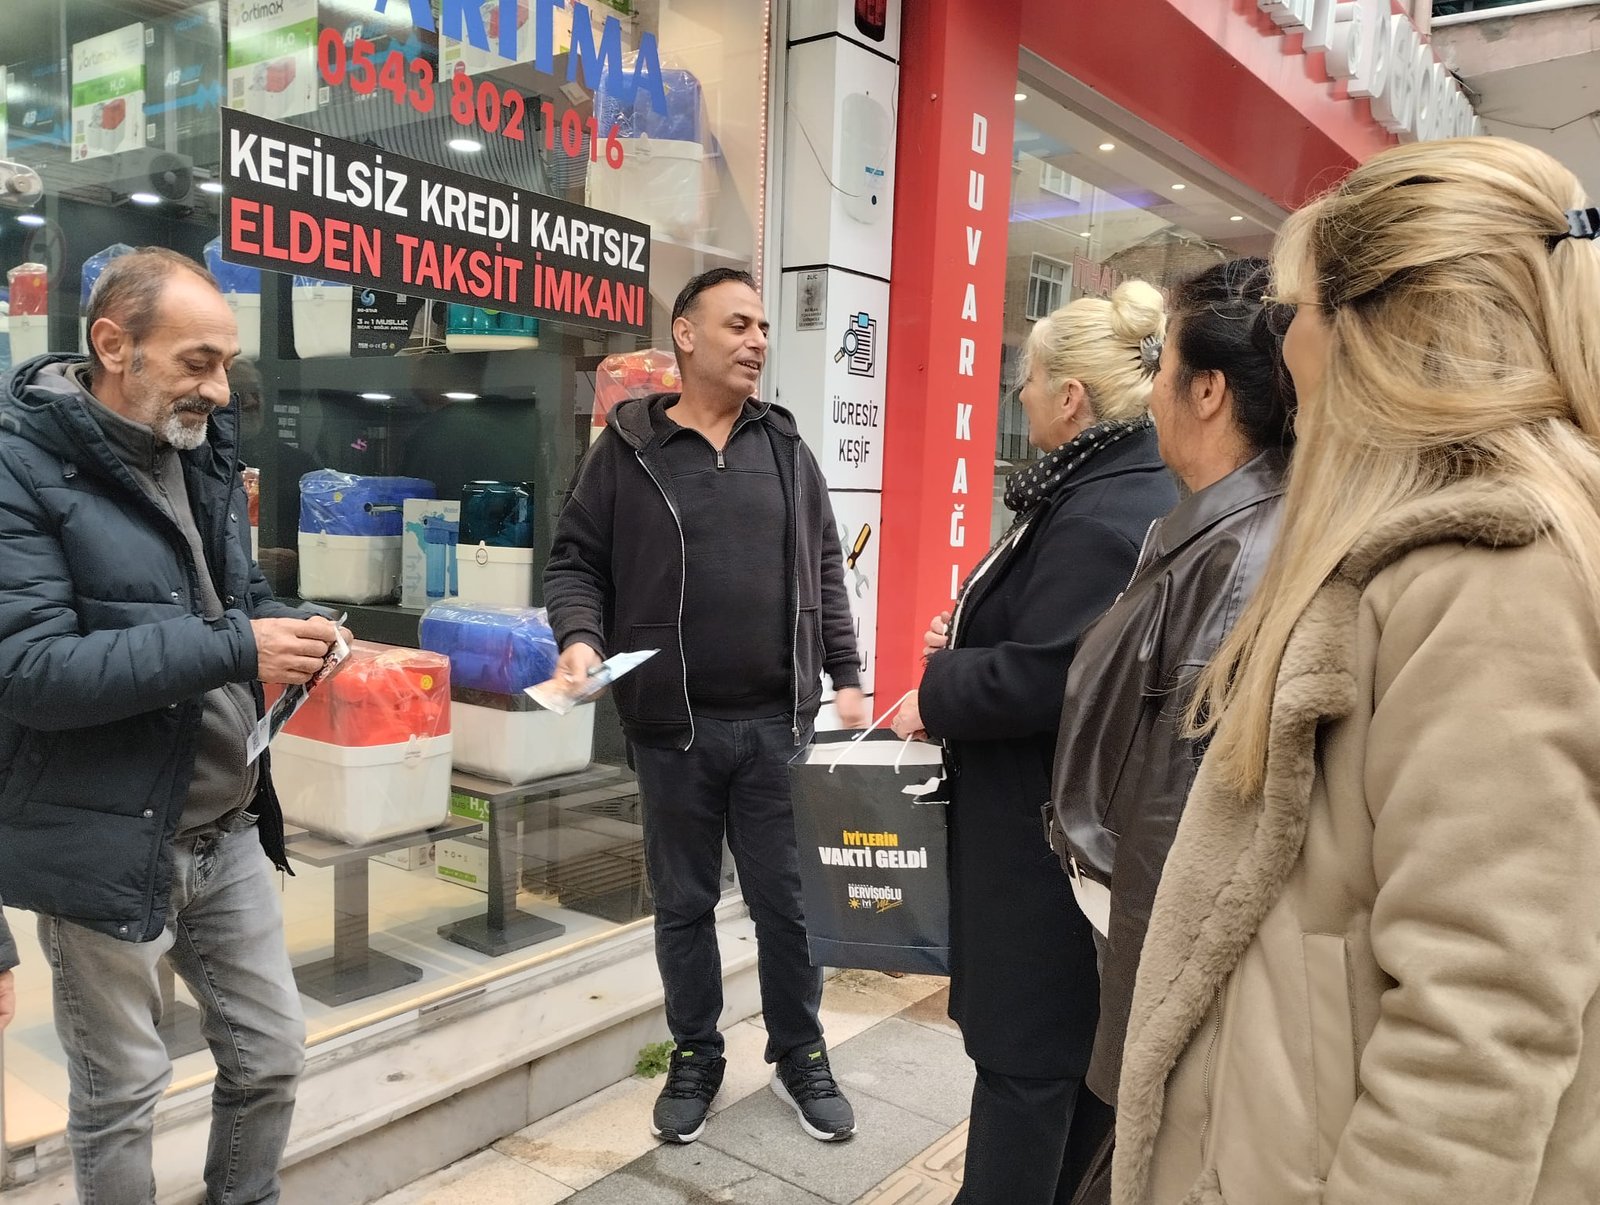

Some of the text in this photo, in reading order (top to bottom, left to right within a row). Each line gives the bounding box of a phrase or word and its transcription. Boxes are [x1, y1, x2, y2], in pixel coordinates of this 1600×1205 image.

[317, 28, 624, 170] 0543 802 1016
[230, 129, 646, 272] KEFİLSİZ KREDİ KARTSIZ
[231, 197, 645, 327] ELDEN TAKSİT İMKANI
[833, 395, 879, 428] ÜCRESİZ
[839, 435, 871, 469] KEŞİF
[818, 846, 928, 869] VAKTİ GELDİ
[848, 885, 902, 902] DERVİŞOĞLU
